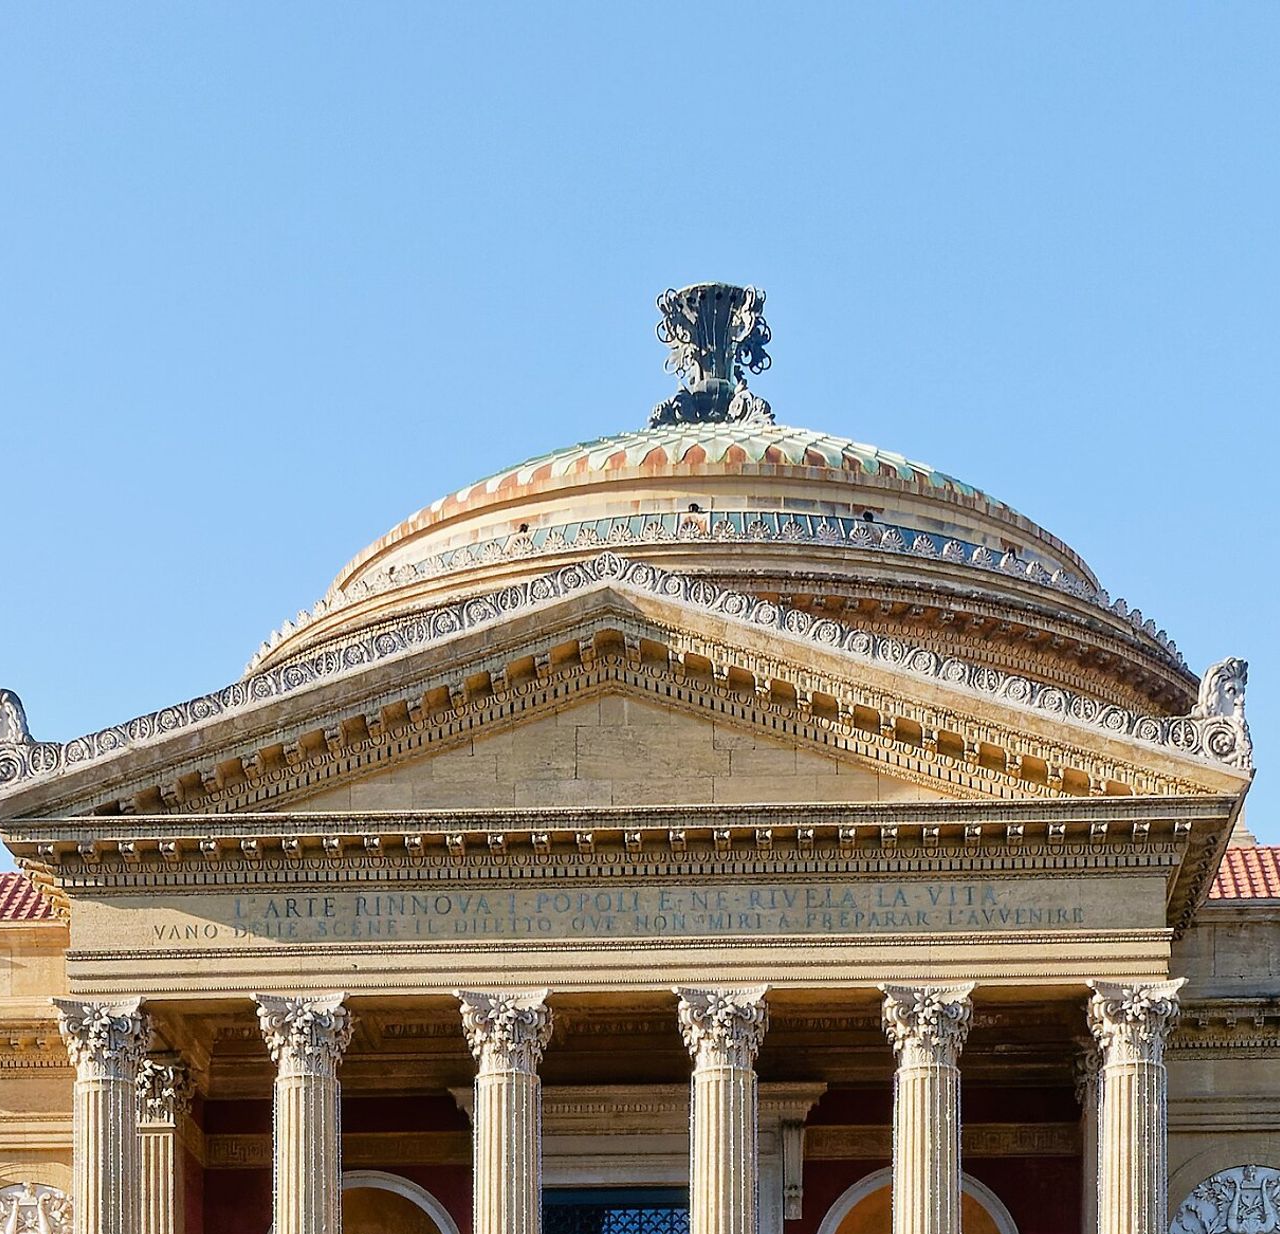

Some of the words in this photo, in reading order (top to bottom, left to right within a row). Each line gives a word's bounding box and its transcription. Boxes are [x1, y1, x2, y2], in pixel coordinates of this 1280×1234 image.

[236, 897, 336, 919] L'ARTE
[356, 894, 492, 917] RINNOVA
[535, 891, 640, 914] POPOLI
[690, 890, 729, 911] NE
[748, 888, 858, 910] RIVELA
[876, 887, 910, 908] LA
[924, 886, 998, 907] VITA
[154, 923, 219, 940] VANO
[232, 921, 298, 939] DELLE
[318, 919, 399, 938] SCENE
[414, 918, 439, 935] IL
[454, 917, 552, 934] DILETTO
[635, 914, 686, 931] NON
[708, 913, 763, 930] MIRI
[805, 909, 931, 929] PREPARAR
[948, 907, 1085, 926] L'AVVENIRE
